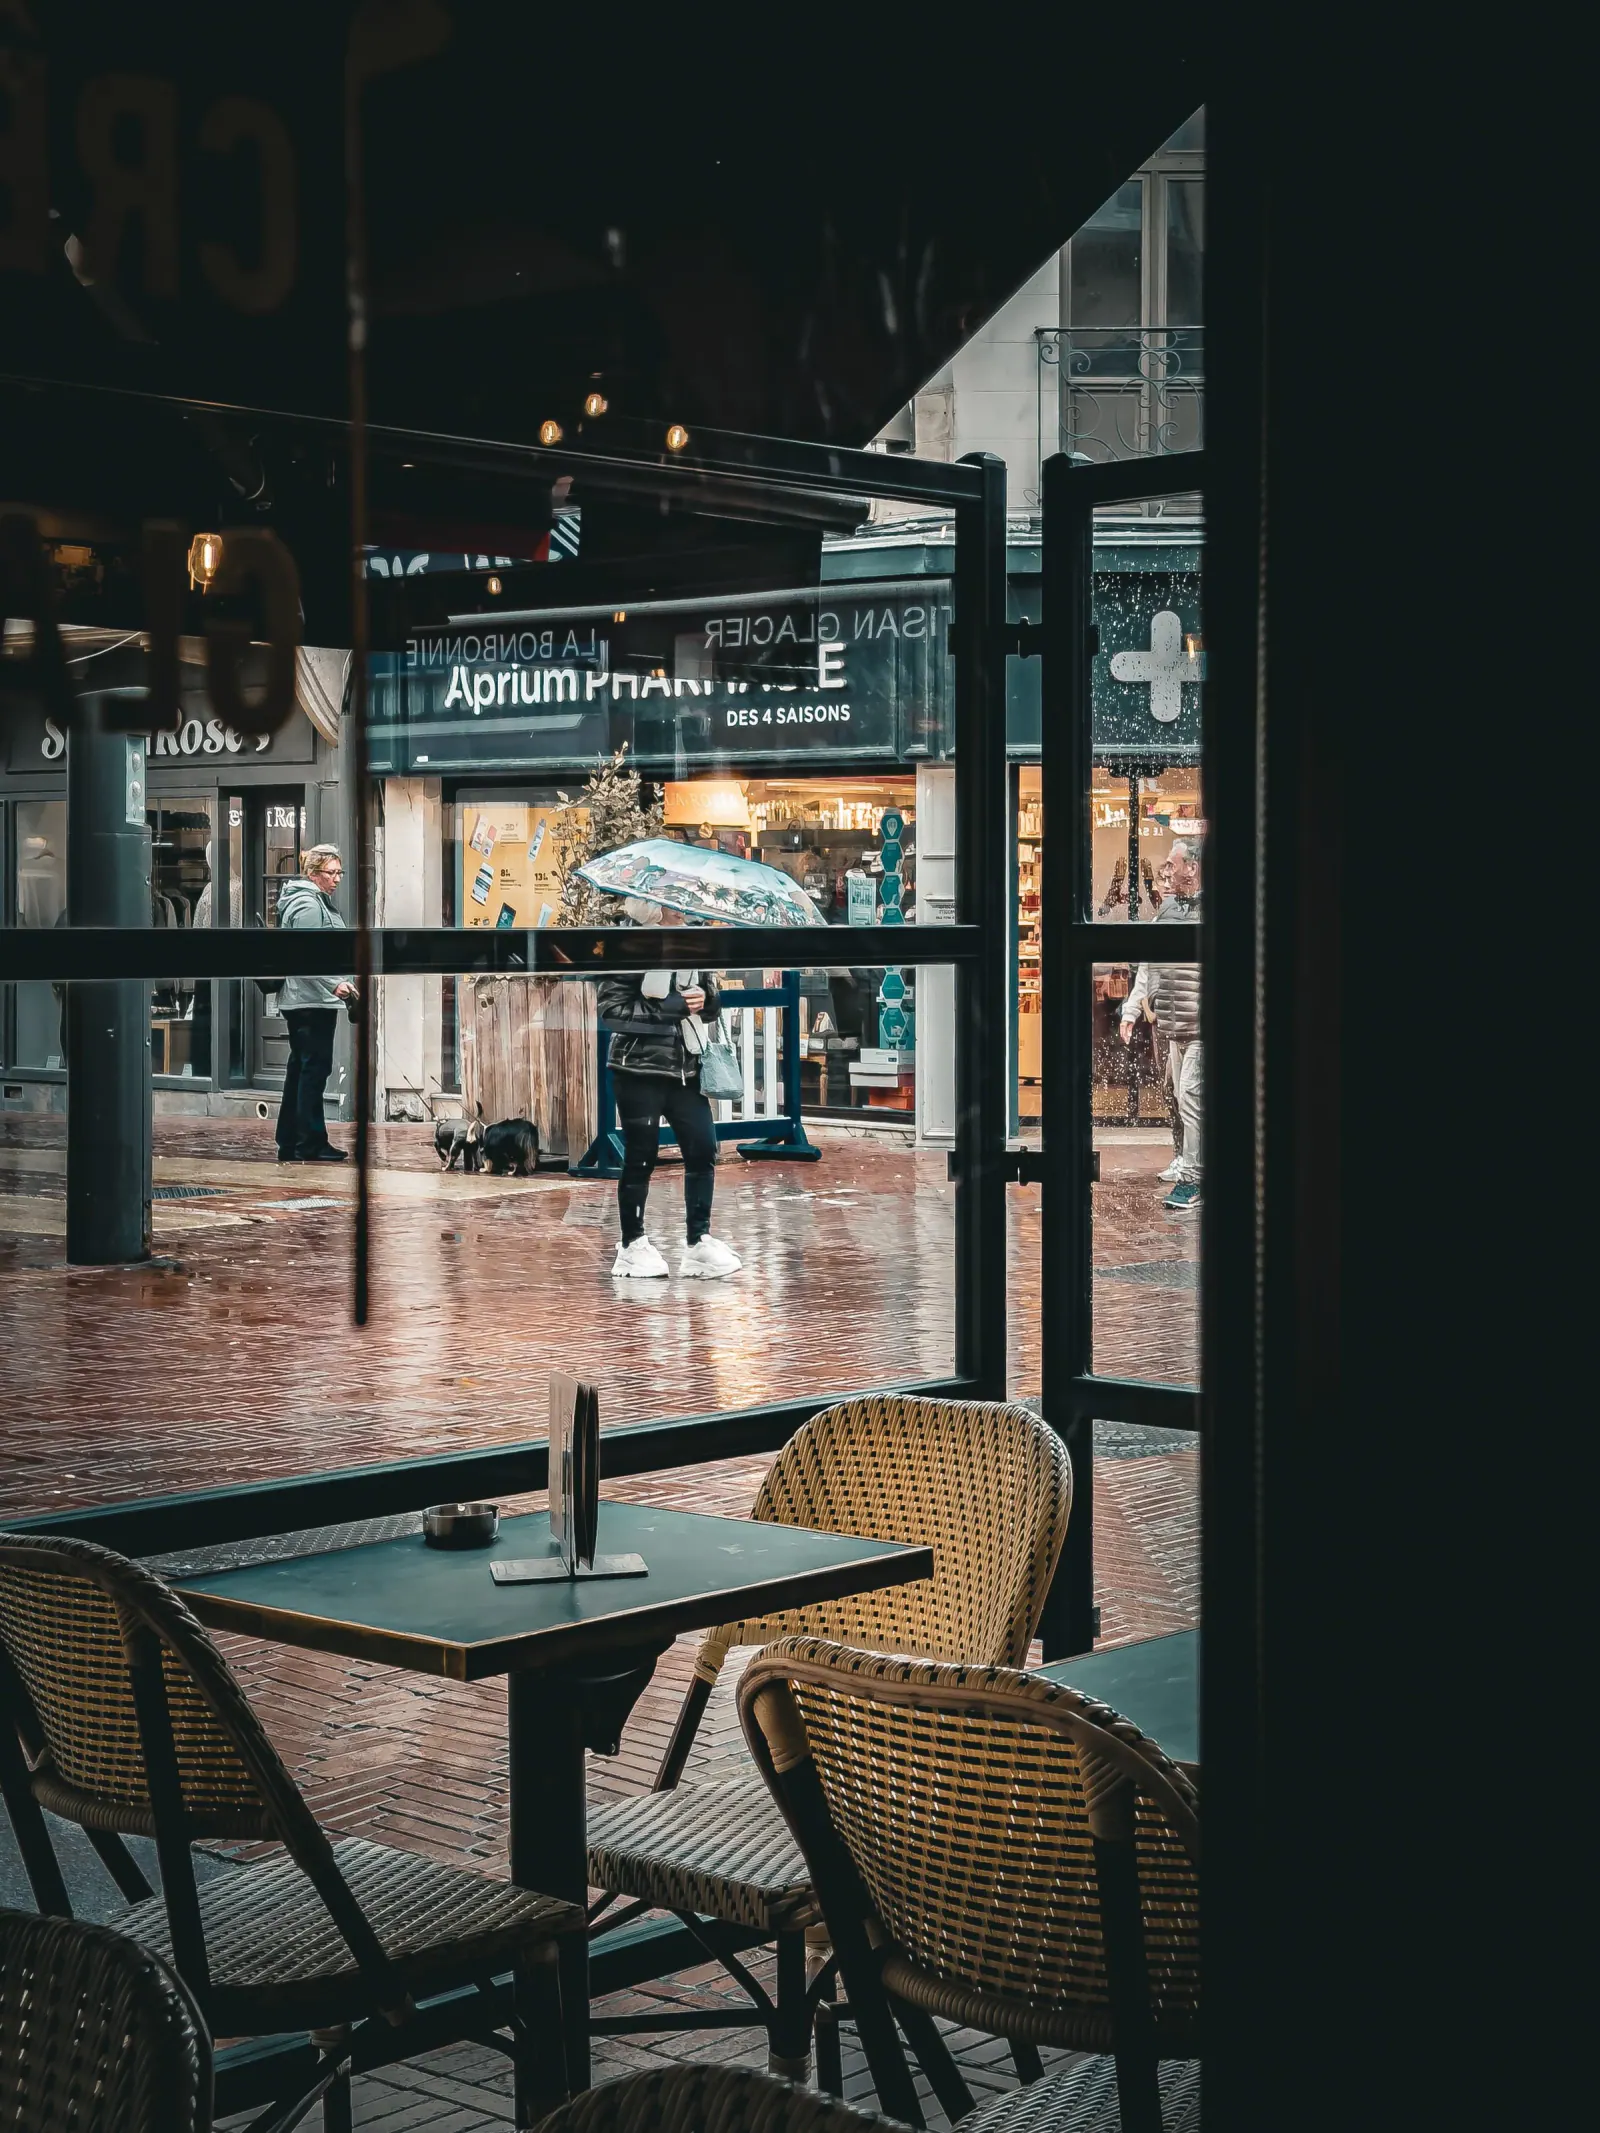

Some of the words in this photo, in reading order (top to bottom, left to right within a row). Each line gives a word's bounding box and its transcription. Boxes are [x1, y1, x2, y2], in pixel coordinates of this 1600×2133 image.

[444, 663, 577, 716] Aprium
[726, 709, 758, 727] DES
[762, 710, 773, 725] 4
[776, 704, 850, 724] SAISONS
